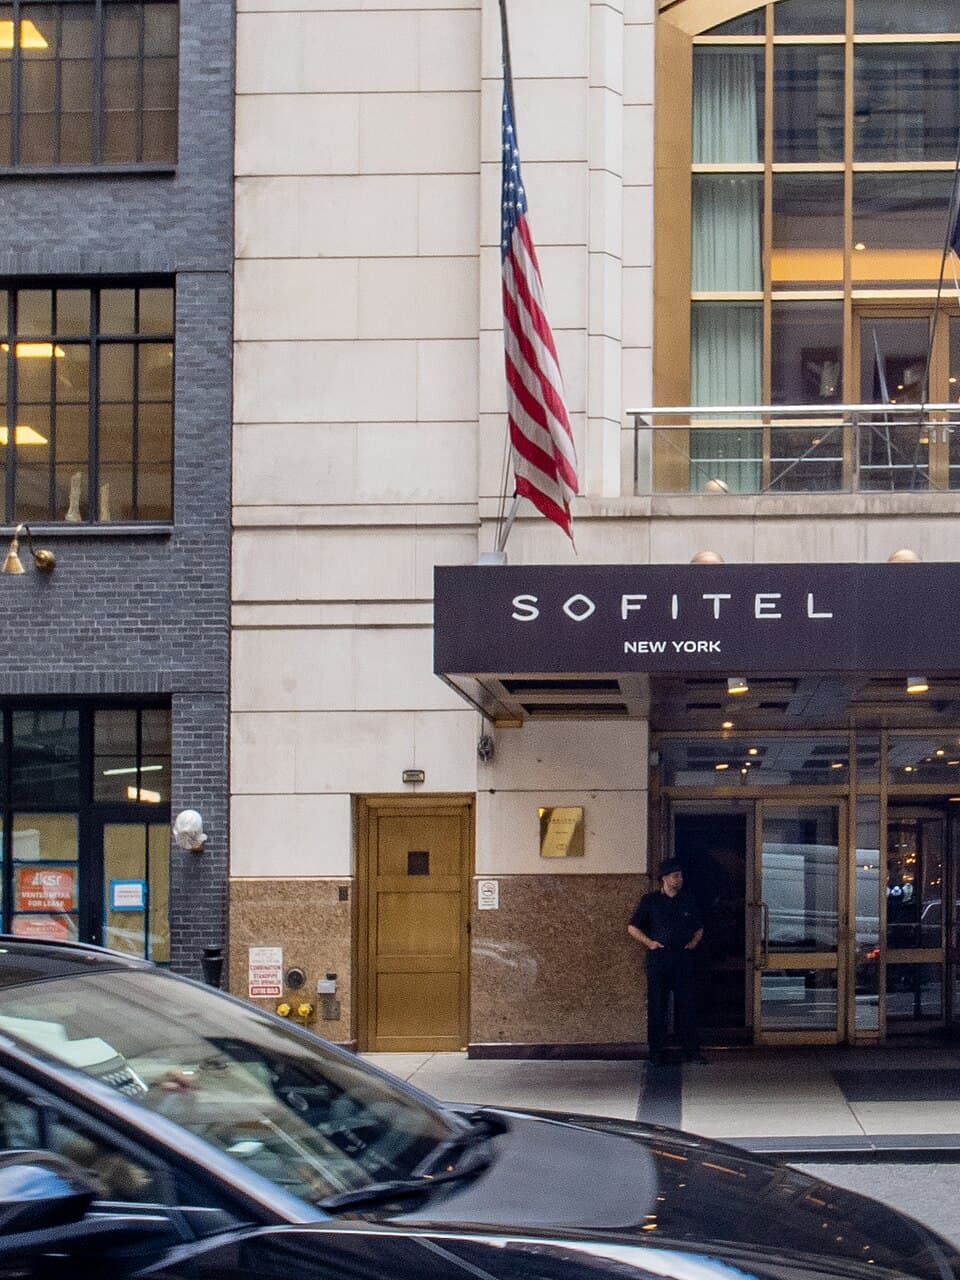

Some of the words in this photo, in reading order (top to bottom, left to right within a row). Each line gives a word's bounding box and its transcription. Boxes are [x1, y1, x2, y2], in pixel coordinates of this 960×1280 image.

[510, 592, 834, 622] SOFITEL
[624, 640, 667, 654] NEW
[671, 640, 721, 654] YORK
